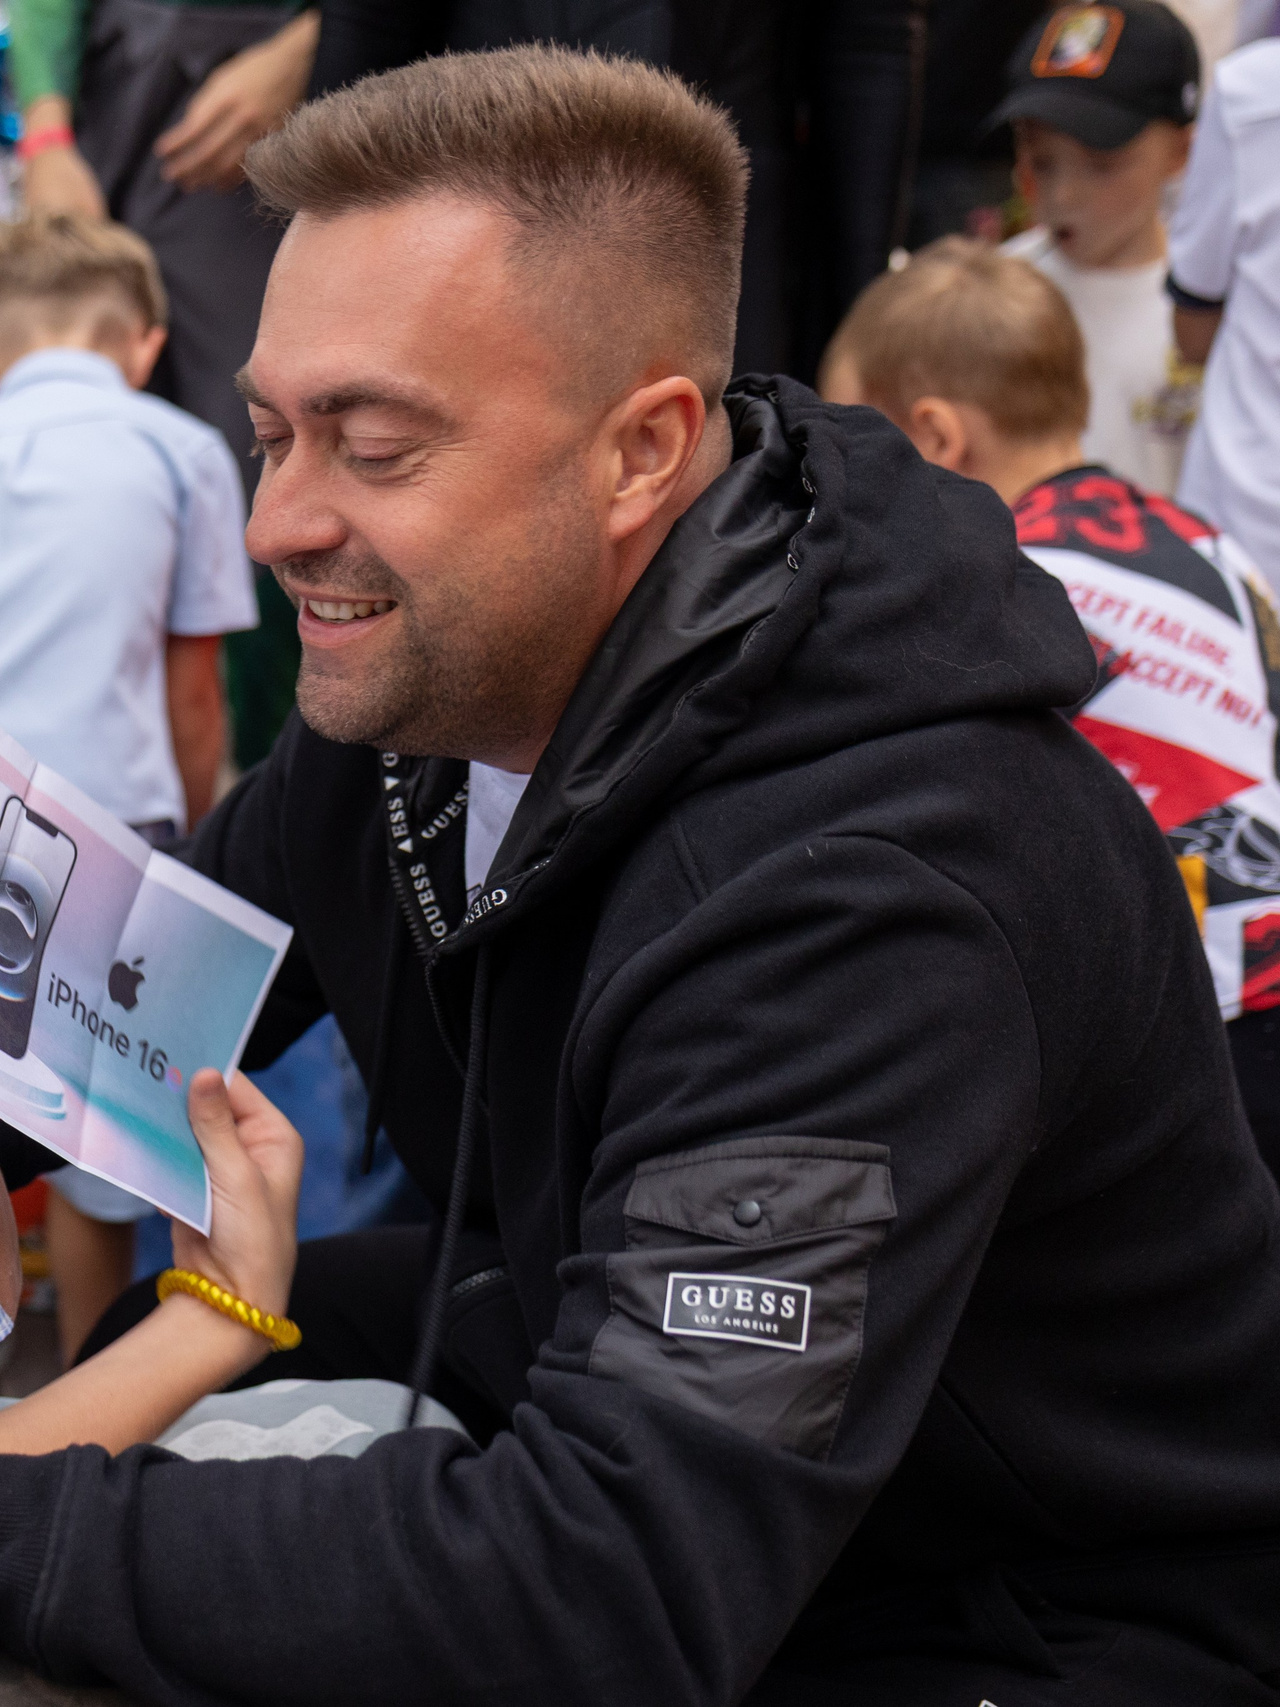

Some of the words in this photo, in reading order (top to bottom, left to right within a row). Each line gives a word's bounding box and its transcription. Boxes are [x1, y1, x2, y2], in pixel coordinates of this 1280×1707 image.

[409, 862, 449, 939] GUESS
[47, 971, 131, 1058] iPhone
[681, 1284, 797, 1320] GUESS
[693, 1314, 718, 1326] LOS
[723, 1316, 780, 1335] ANGELES
